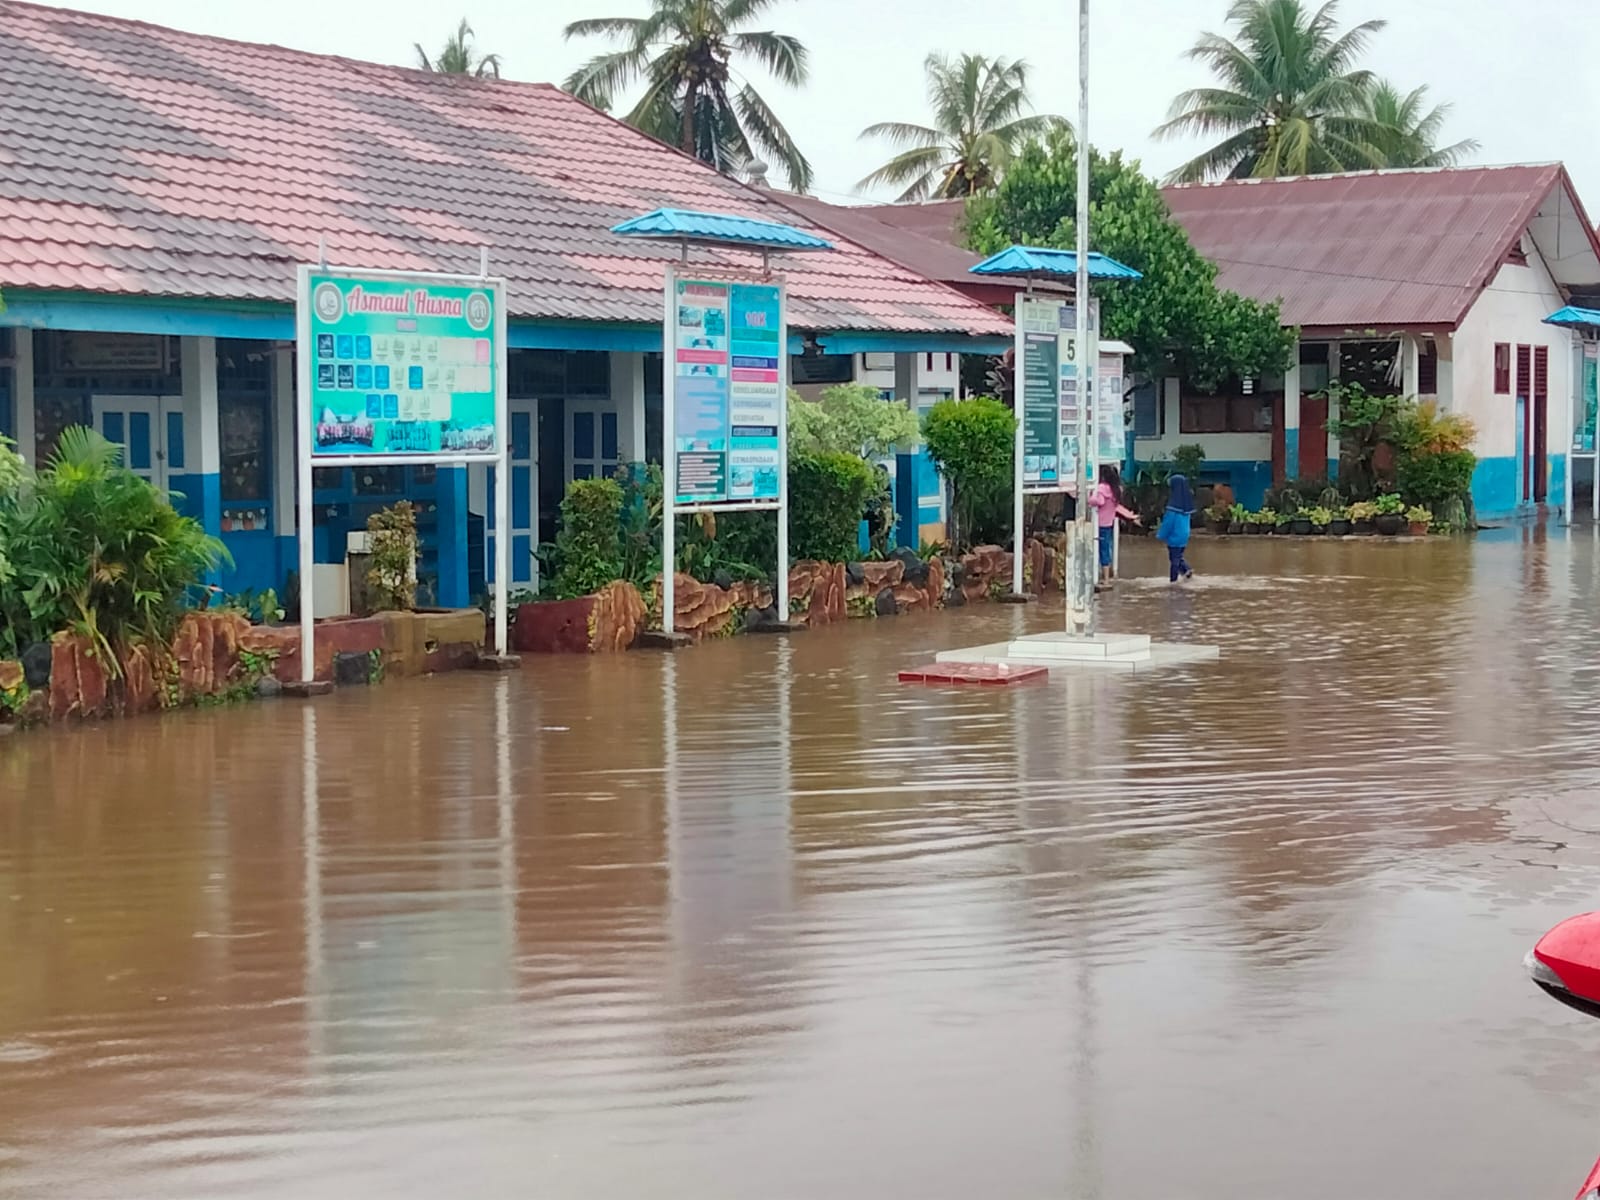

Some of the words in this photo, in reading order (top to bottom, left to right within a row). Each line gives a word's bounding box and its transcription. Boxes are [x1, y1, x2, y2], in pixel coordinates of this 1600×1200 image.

[347, 286, 410, 314] Asmaul
[414, 290, 462, 316] Husna
[1067, 338, 1076, 361] 5
